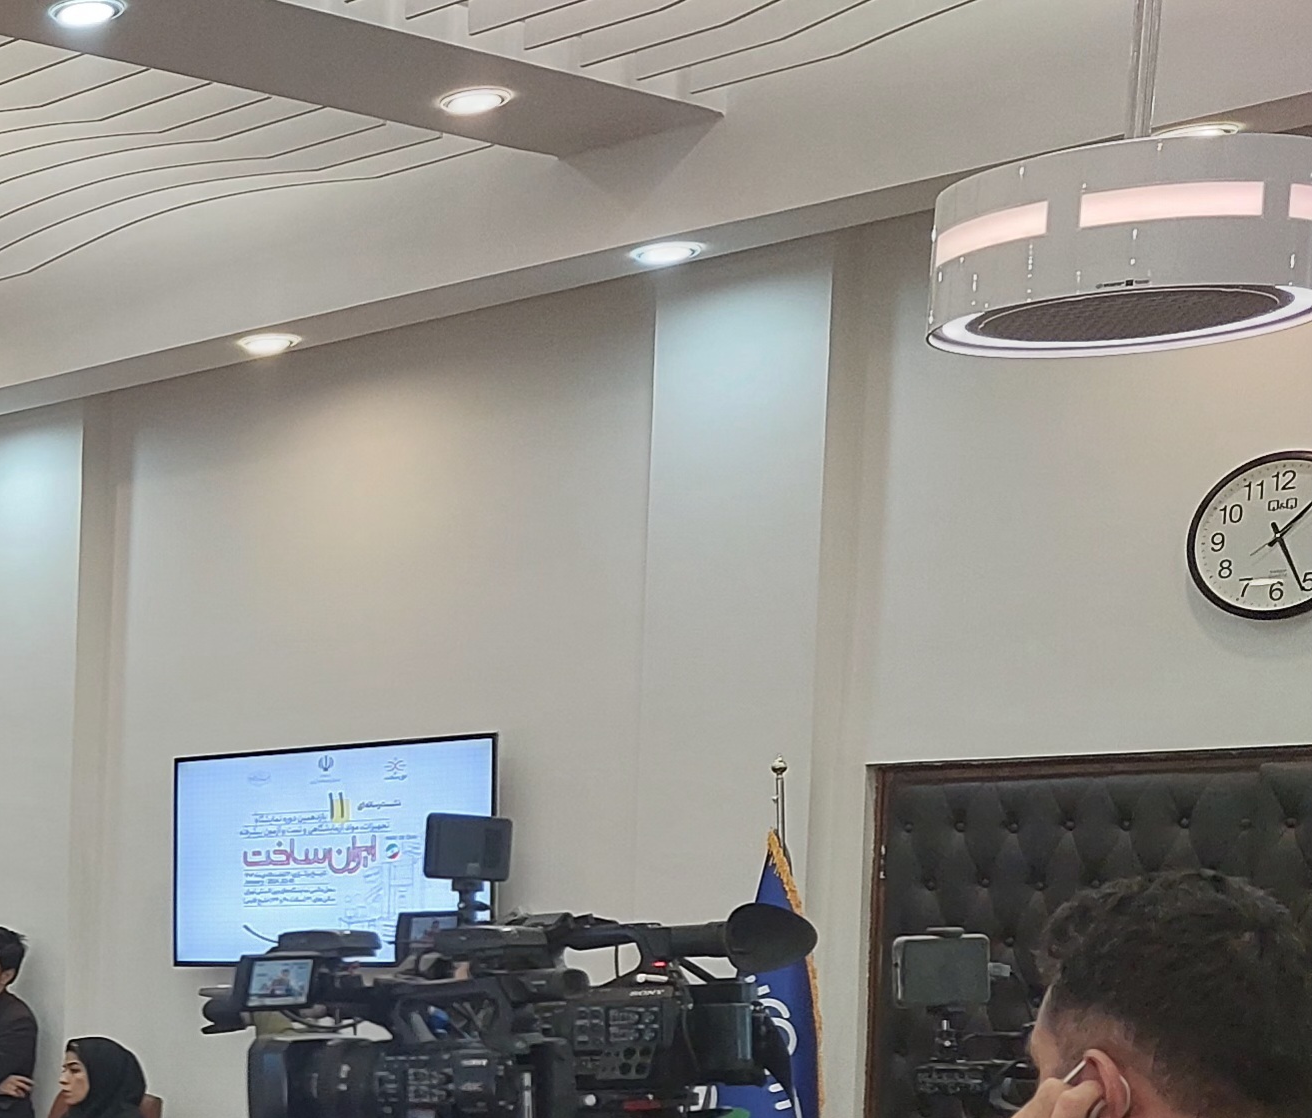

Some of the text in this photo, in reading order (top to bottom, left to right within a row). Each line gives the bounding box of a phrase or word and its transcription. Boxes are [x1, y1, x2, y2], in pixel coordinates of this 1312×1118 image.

[1244, 480, 1265, 501] 11
[1271, 470, 1297, 491] 12
[1219, 504, 1243, 525] 10
[1210, 532, 1225, 553] 9
[1218, 559, 1233, 579] 8
[1239, 577, 1254, 598] 7
[1269, 581, 1284, 602] 6
